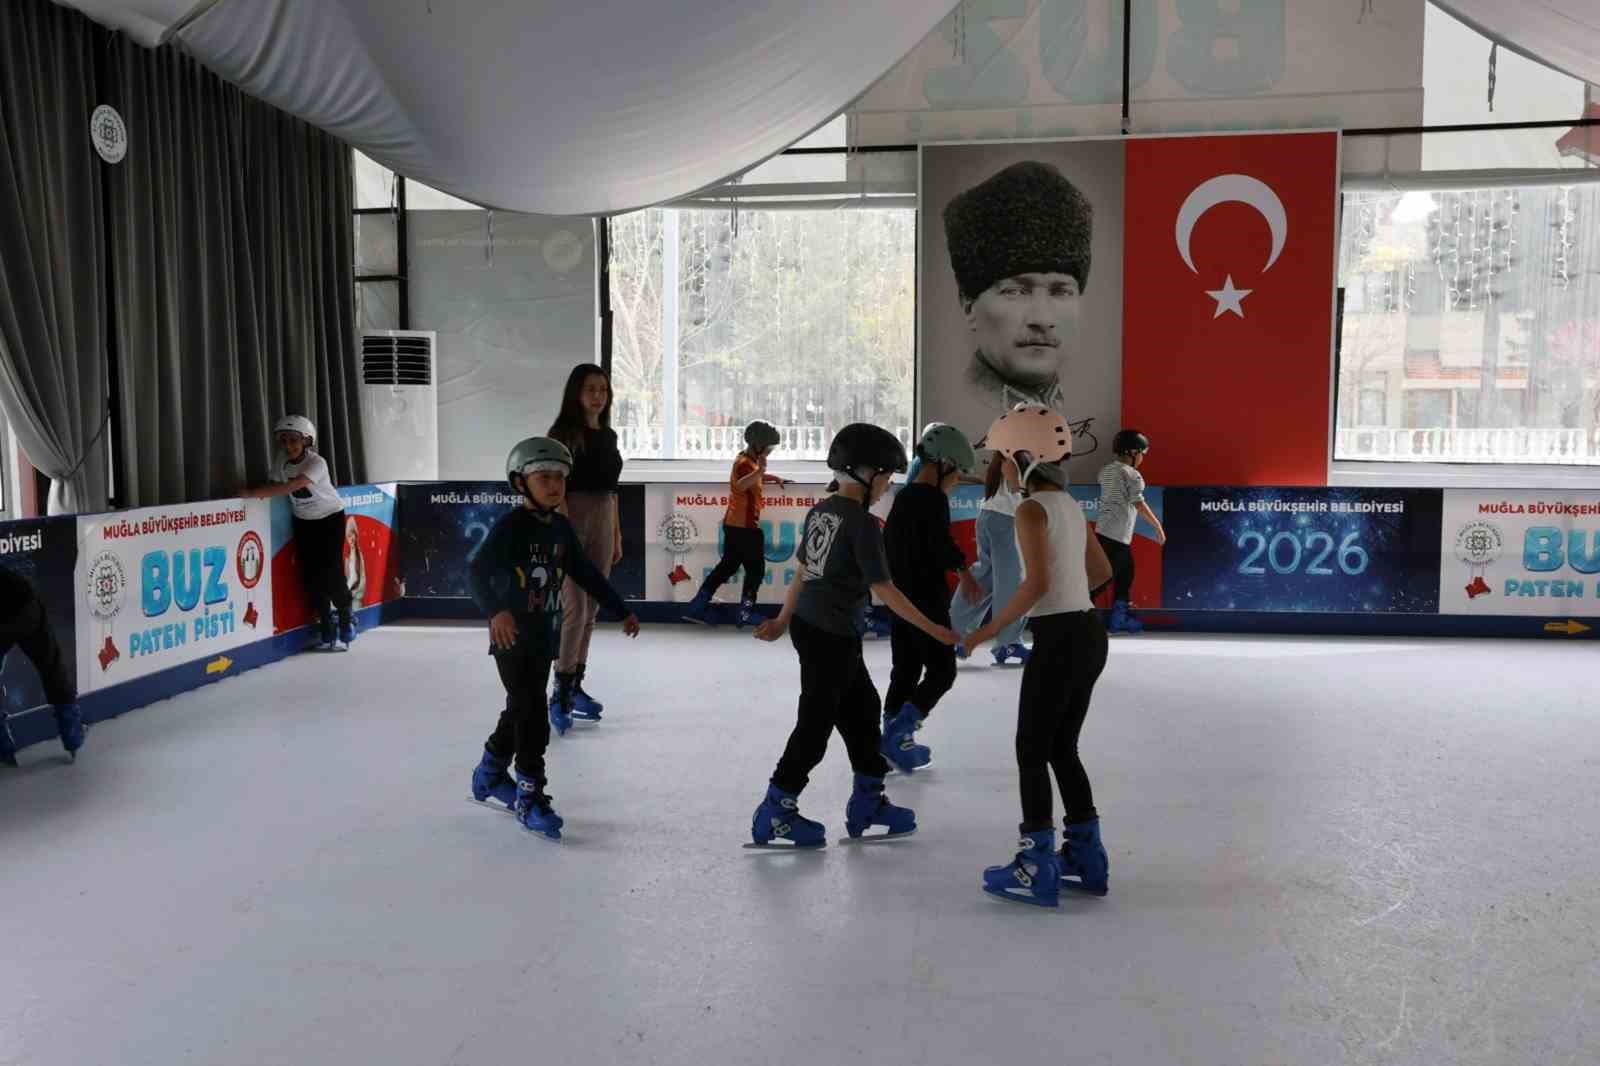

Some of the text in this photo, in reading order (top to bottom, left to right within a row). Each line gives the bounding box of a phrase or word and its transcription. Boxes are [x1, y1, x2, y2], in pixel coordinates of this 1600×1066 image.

[431, 491, 524, 508] MUĞLA BÜYÜKŞE
[677, 494, 718, 506] MUĞLA
[1201, 499, 1405, 516] MUĞLA BÜYÜKŞEHİR BELEDİYESİ
[1478, 501, 1600, 518] MUĞLA BÜYÜKŞEHİ
[103, 504, 247, 540] MUĞLA BÜYÜKŞEHİR BELEDİYESİ
[0, 529, 42, 554] DİYESİ
[1237, 531, 1370, 575] 2026
[1522, 526, 1600, 574] BU
[142, 545, 229, 618] BUZ
[1504, 579, 1584, 598] PATEN
[129, 601, 235, 658] PATEN PİSTİ
